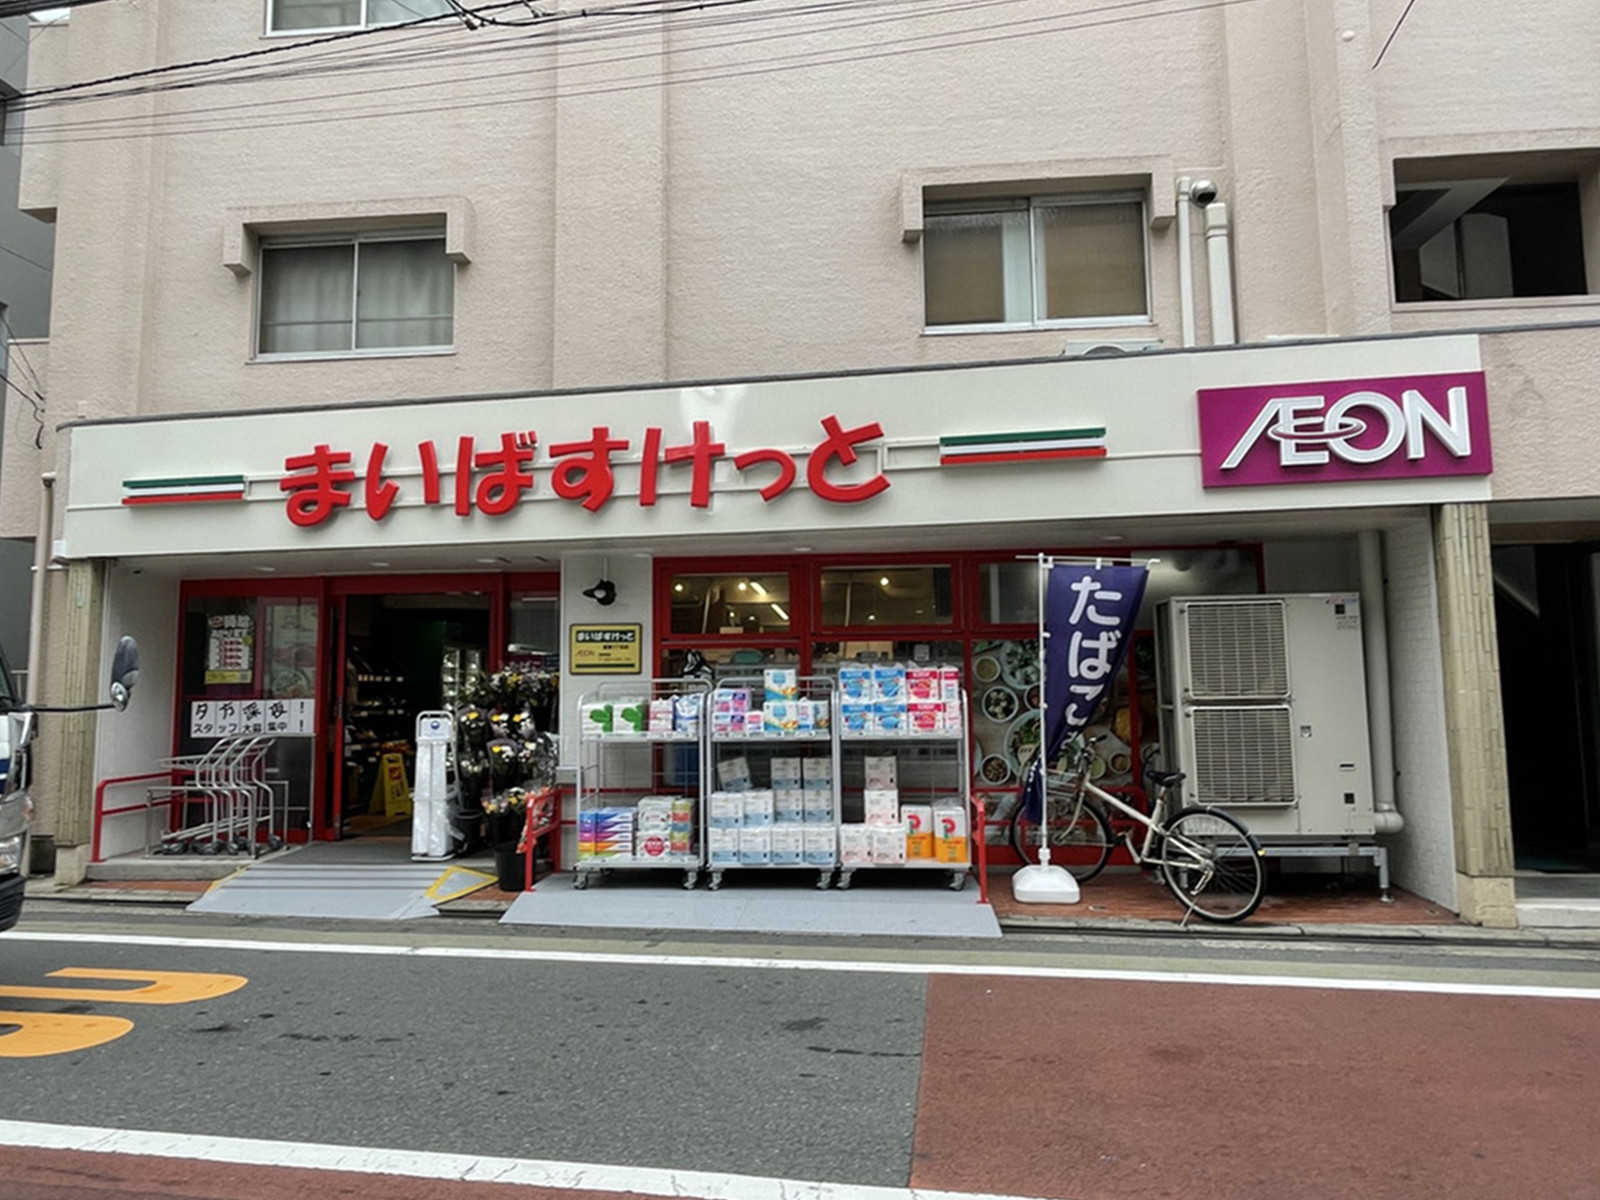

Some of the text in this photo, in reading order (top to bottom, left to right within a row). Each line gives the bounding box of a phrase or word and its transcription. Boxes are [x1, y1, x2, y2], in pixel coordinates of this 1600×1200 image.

[280, 414, 892, 528] まいばすけっと
